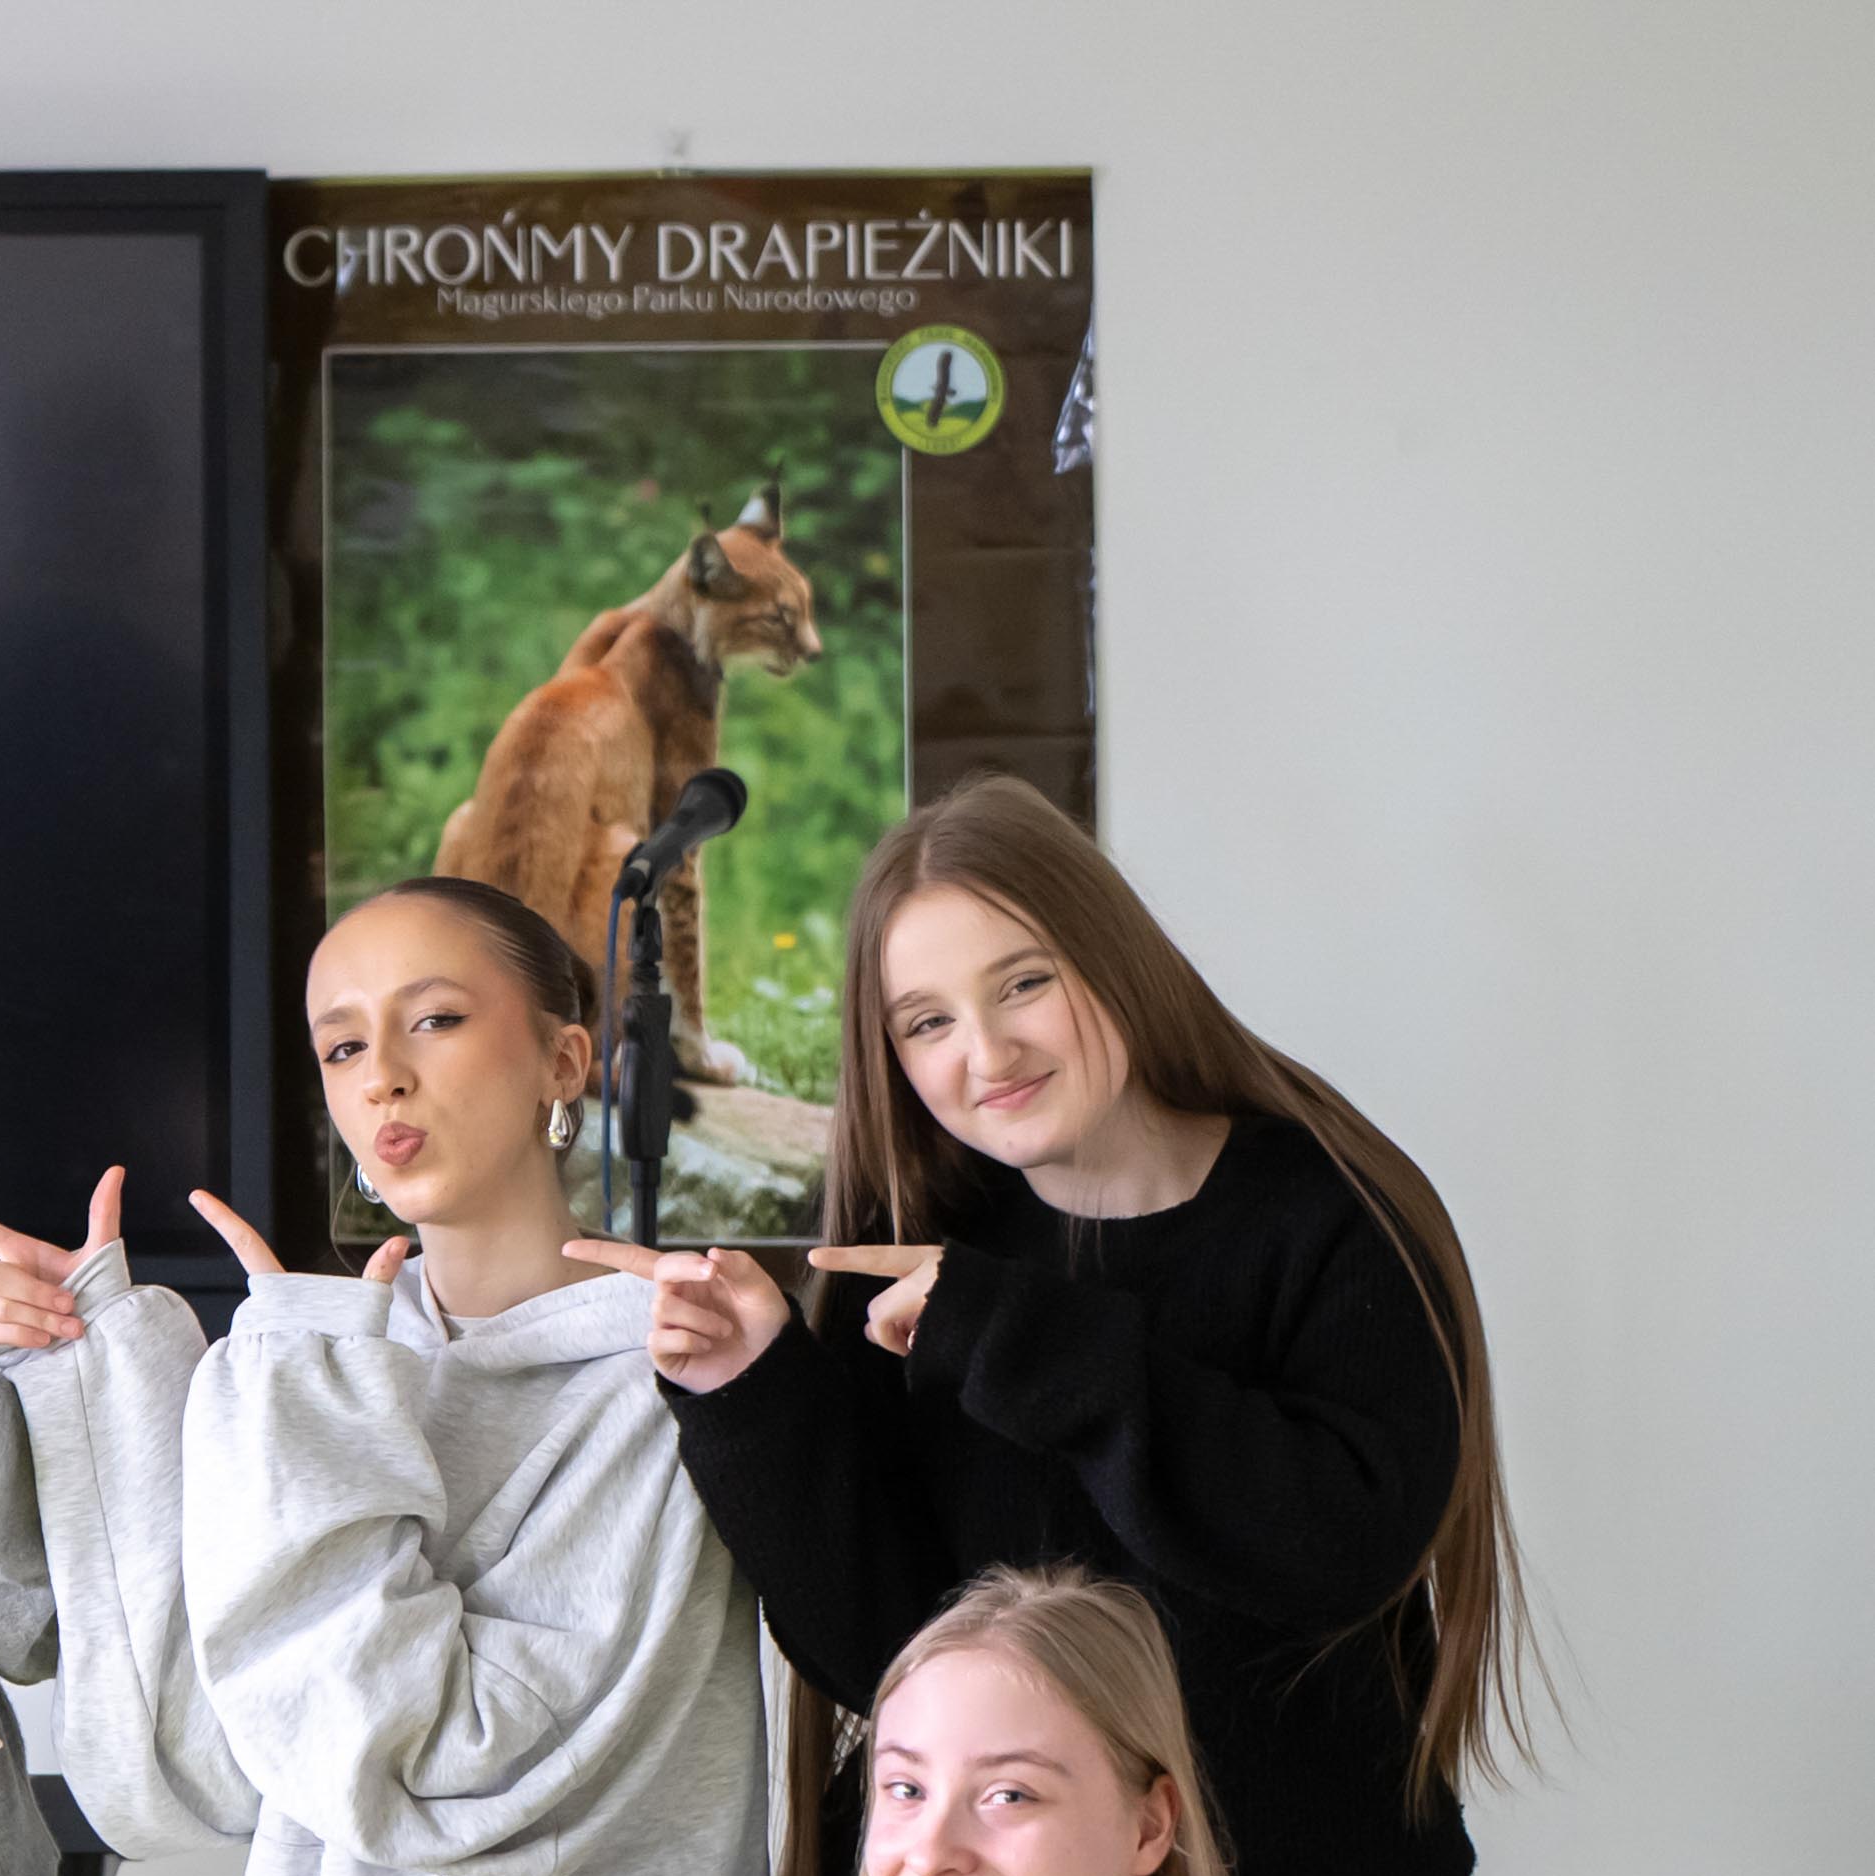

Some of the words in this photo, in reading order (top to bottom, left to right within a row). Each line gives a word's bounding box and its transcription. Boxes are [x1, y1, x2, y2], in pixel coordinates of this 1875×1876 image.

[283, 209, 635, 287] CHROŃMY
[657, 208, 1074, 282] DRAPIEŻNIKI
[436, 286, 624, 320] Magurskiego
[632, 283, 713, 314] Parku
[722, 283, 920, 318] Narodowego
